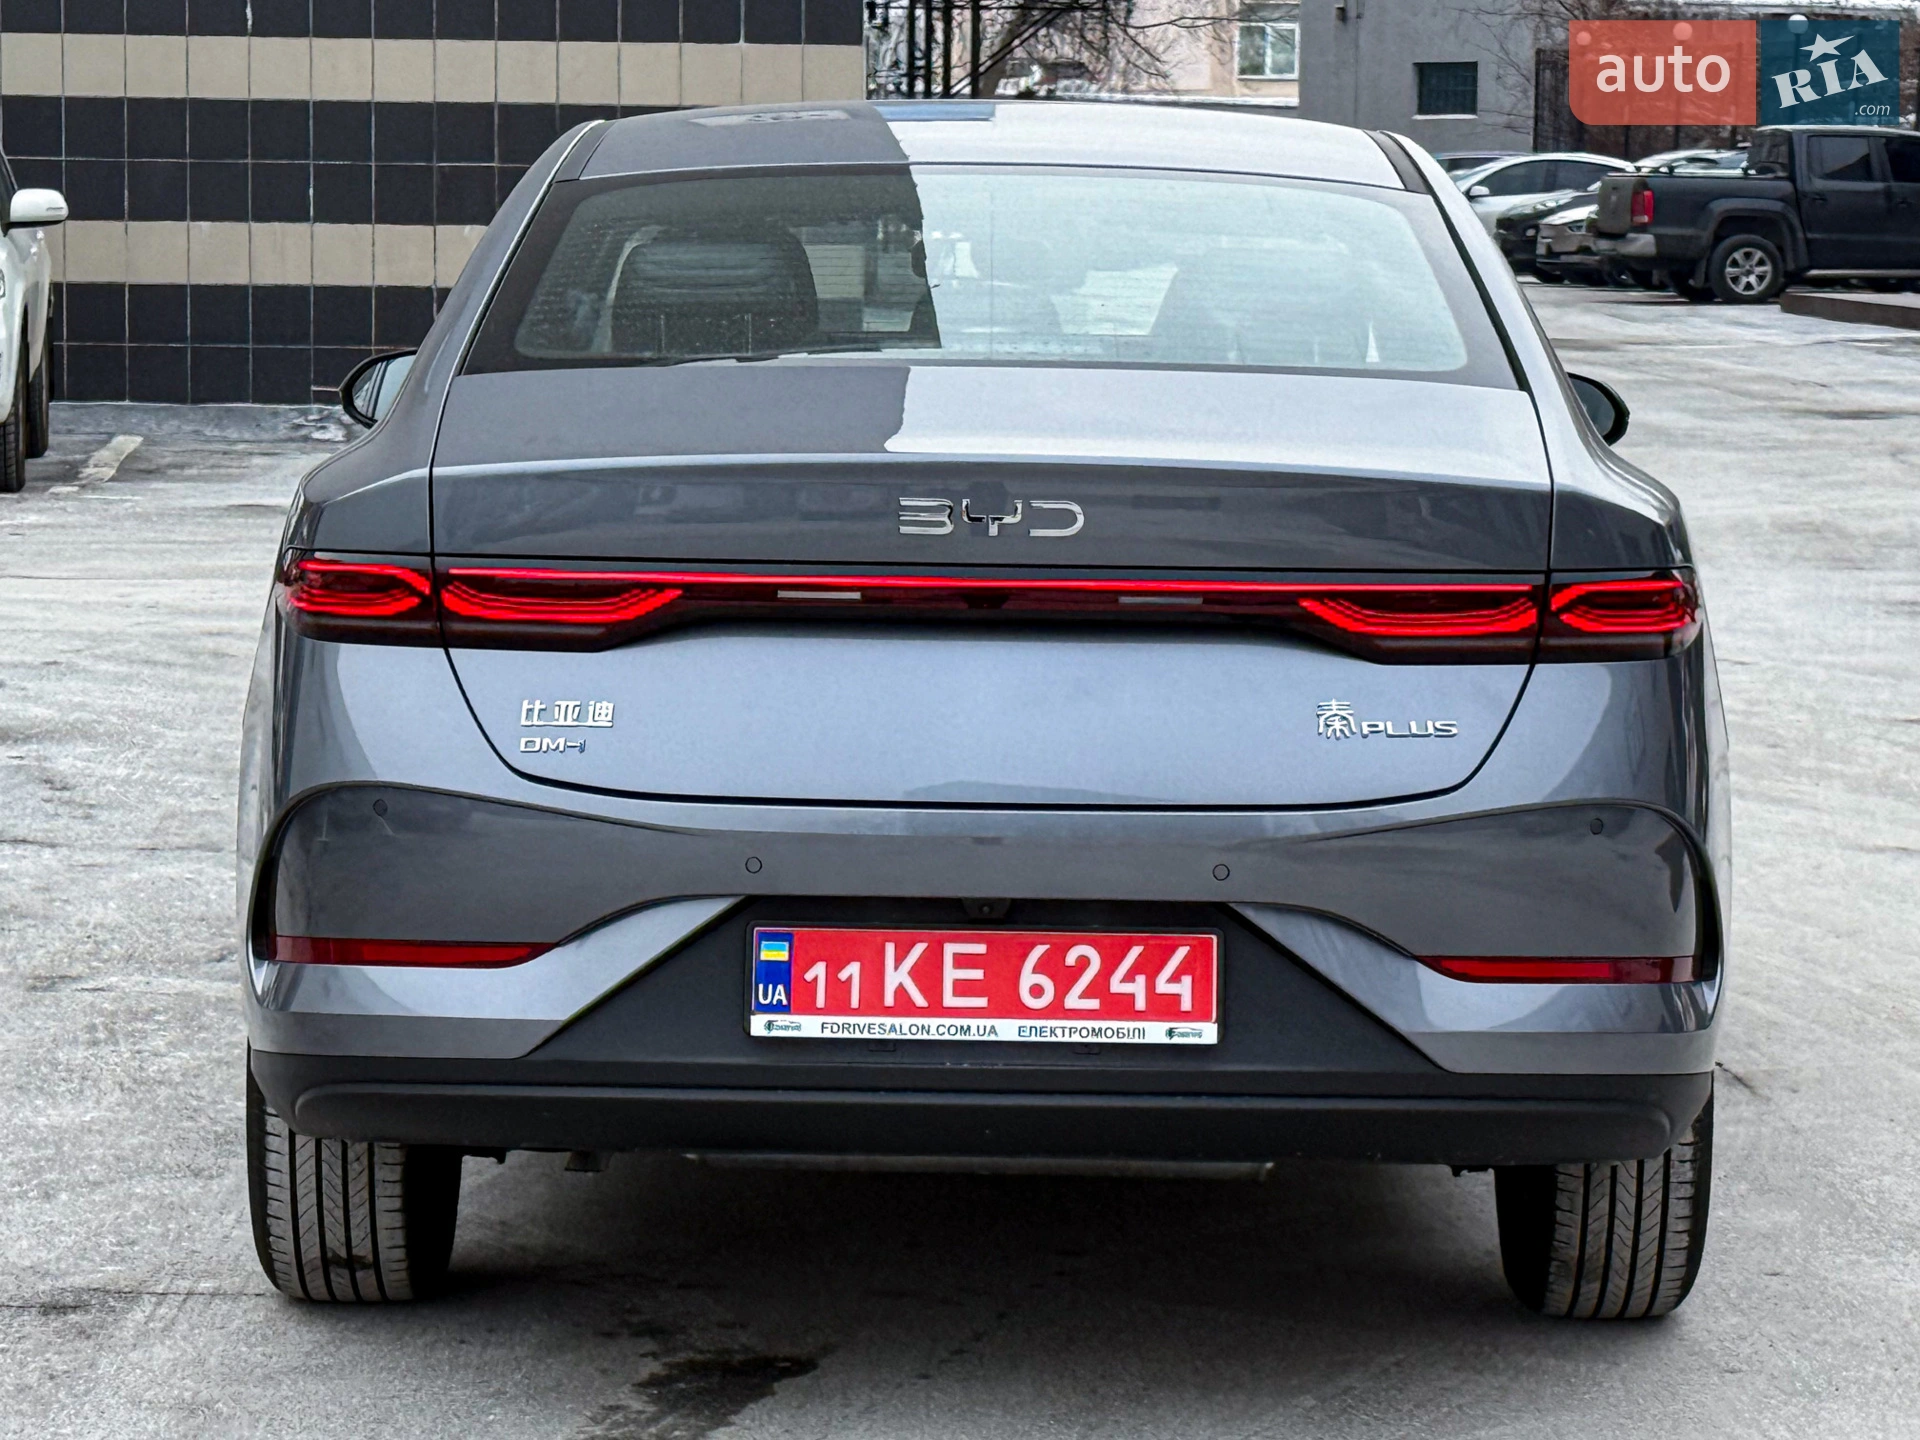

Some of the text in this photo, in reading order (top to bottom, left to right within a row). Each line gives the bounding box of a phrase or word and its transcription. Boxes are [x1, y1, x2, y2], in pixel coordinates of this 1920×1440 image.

[899, 497, 1085, 537] BYD
[520, 699, 615, 728] 比亚迪
[883, 941, 989, 1009] KE
[1018, 943, 1194, 1012] 6244
[758, 984, 788, 1006] UA
